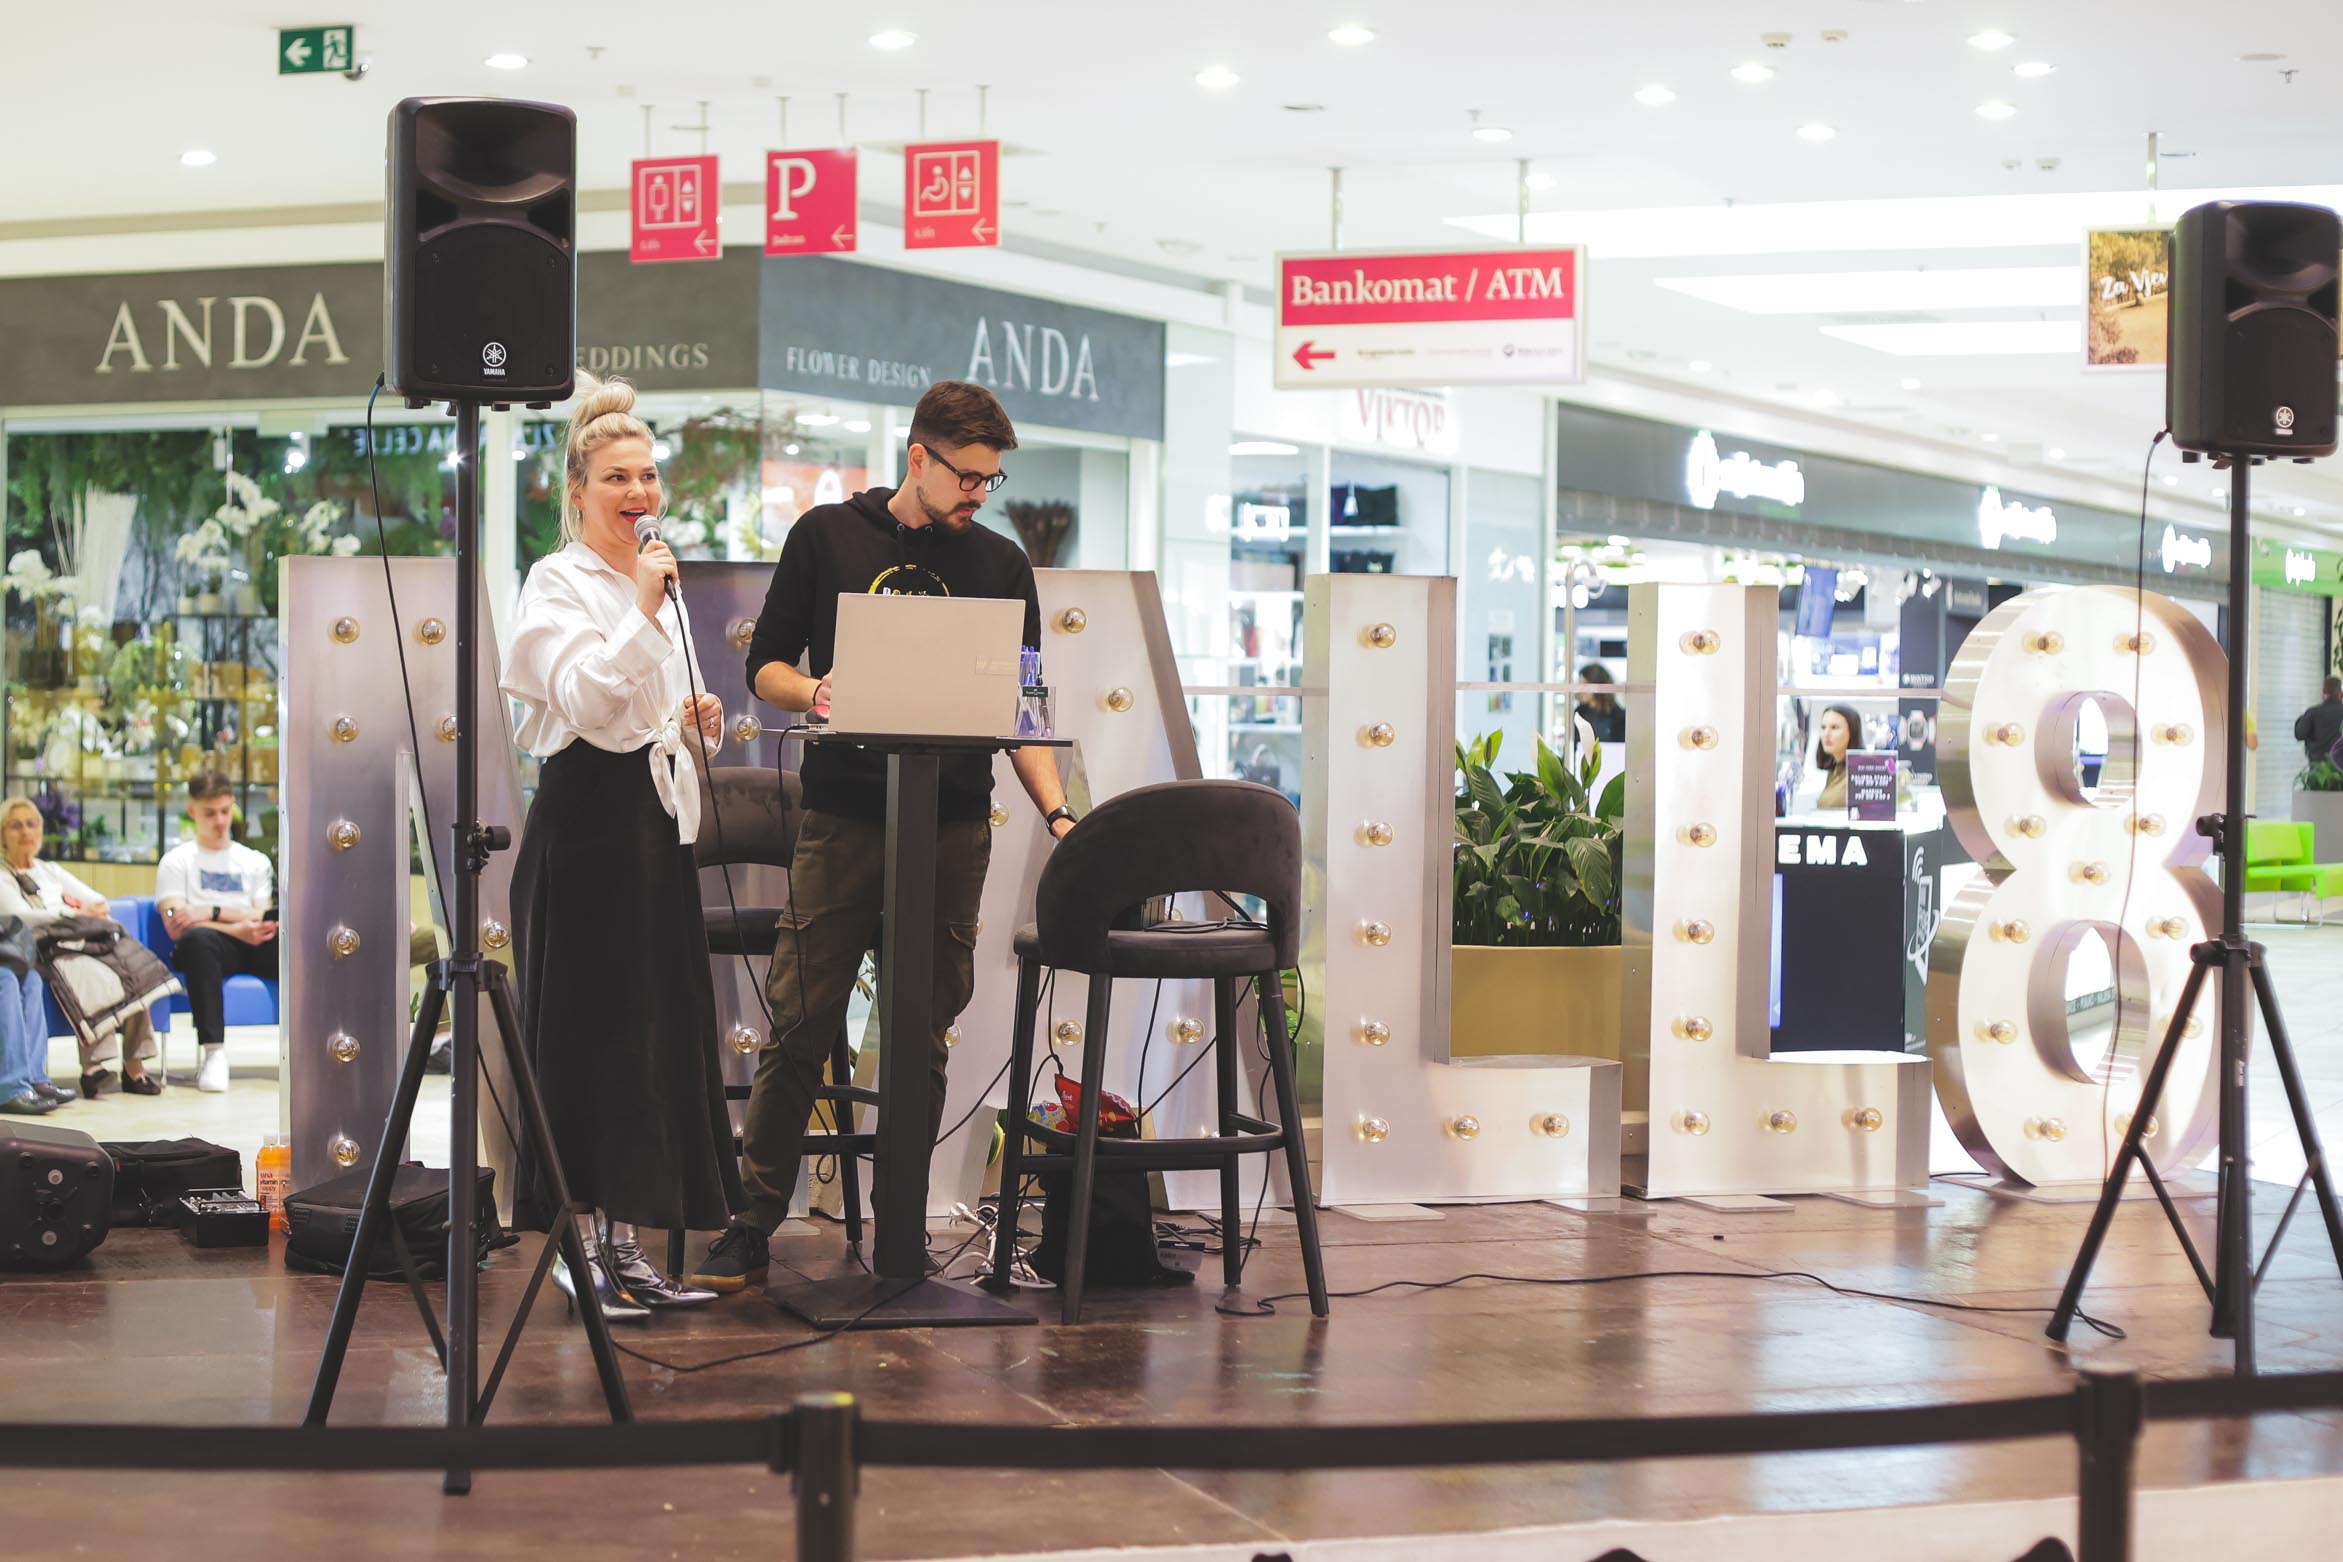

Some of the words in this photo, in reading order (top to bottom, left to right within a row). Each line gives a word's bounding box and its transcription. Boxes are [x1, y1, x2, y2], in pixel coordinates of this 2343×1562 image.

[771, 158, 816, 221] P
[1291, 269, 1458, 306] Bankomat
[1485, 266, 1565, 301] ATM
[95, 291, 350, 374] ANDA
[964, 315, 1100, 402] ANDA
[483, 368, 506, 376] YAMAHA
[785, 346, 860, 379] FLOWER
[867, 359, 932, 388] DESIGN
